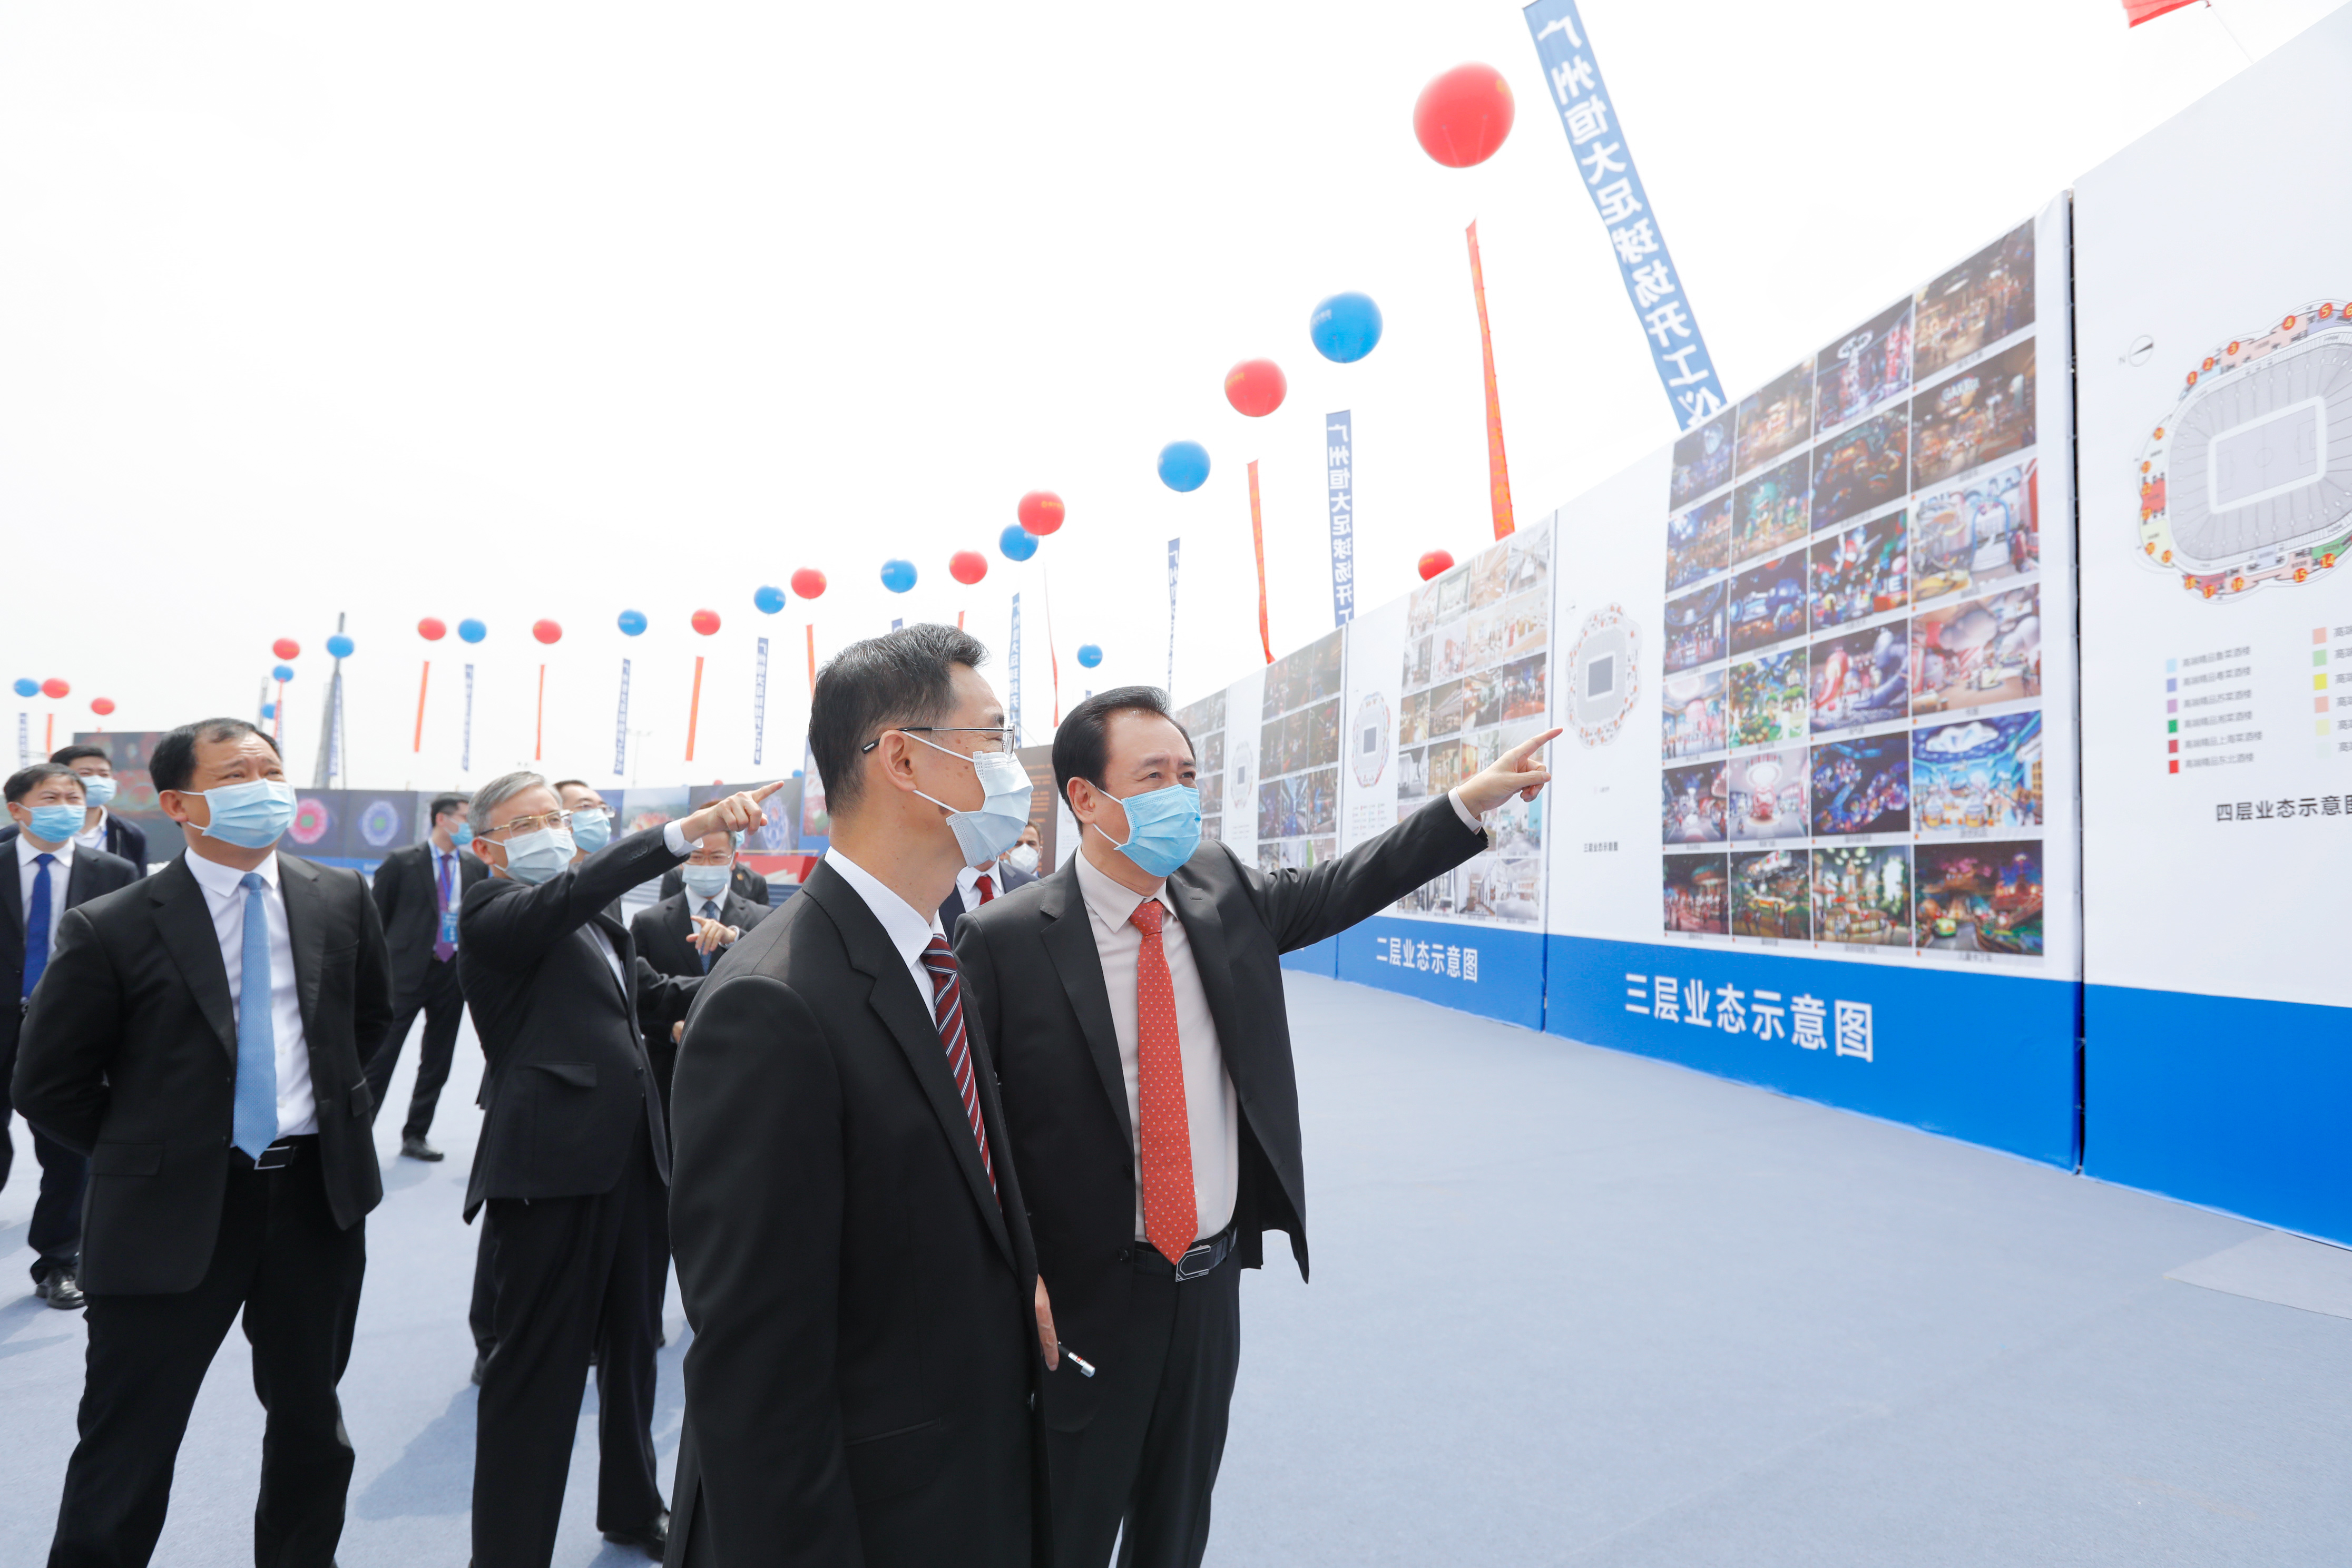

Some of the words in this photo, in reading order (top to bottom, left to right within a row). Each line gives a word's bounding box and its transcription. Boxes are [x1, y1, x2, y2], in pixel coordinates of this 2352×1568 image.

[2321, 305, 2330, 317] 5
[2285, 317, 2293, 328] 4
[2229, 343, 2237, 354] 3
[2204, 359, 2212, 370] 2
[2320, 555, 2335, 568] 14
[2294, 570, 2307, 582] 15
[1376, 937, 1478, 983] 二层业态示意图
[1625, 973, 1874, 1063] 三层业态示意图
